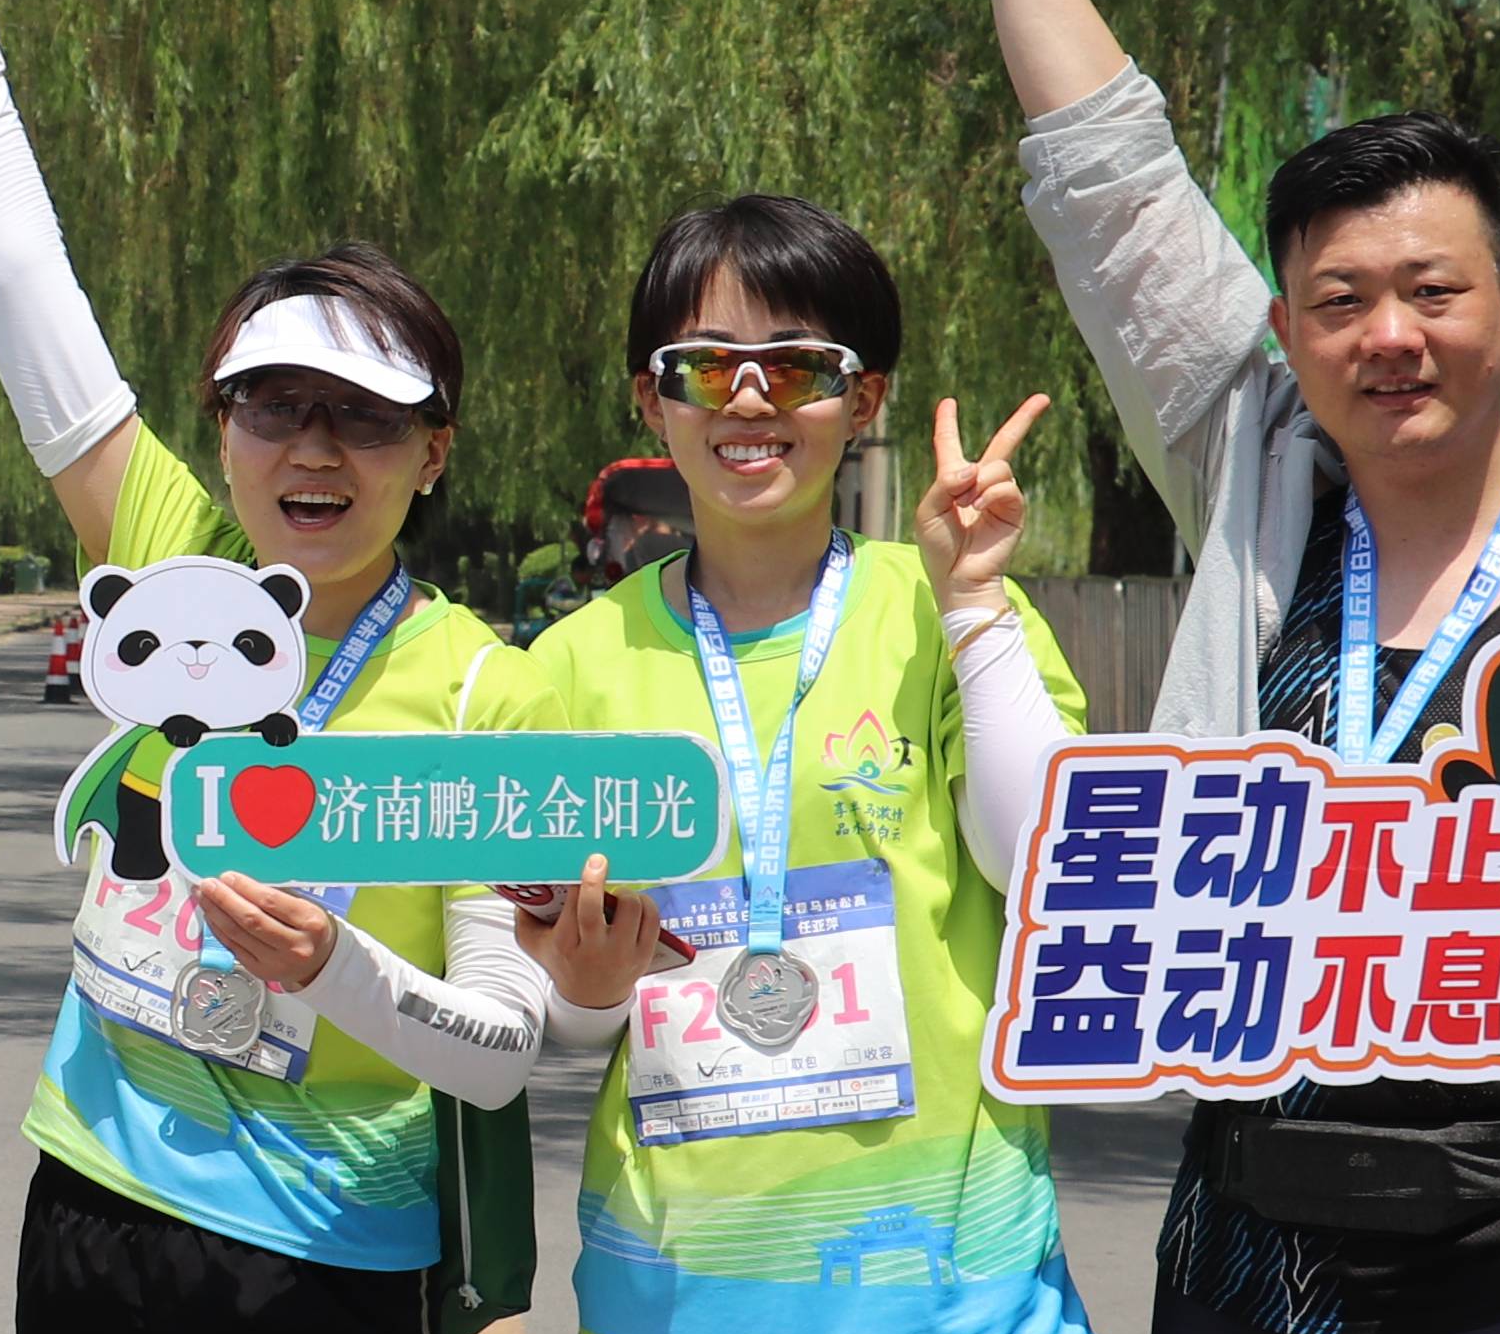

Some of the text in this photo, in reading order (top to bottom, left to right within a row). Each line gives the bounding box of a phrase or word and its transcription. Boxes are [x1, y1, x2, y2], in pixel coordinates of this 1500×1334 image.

[195, 765, 697, 848] I 济南鹏龙金阳光
[790, 1054, 818, 1071] 取包
[863, 1045, 895, 1062] 收容
